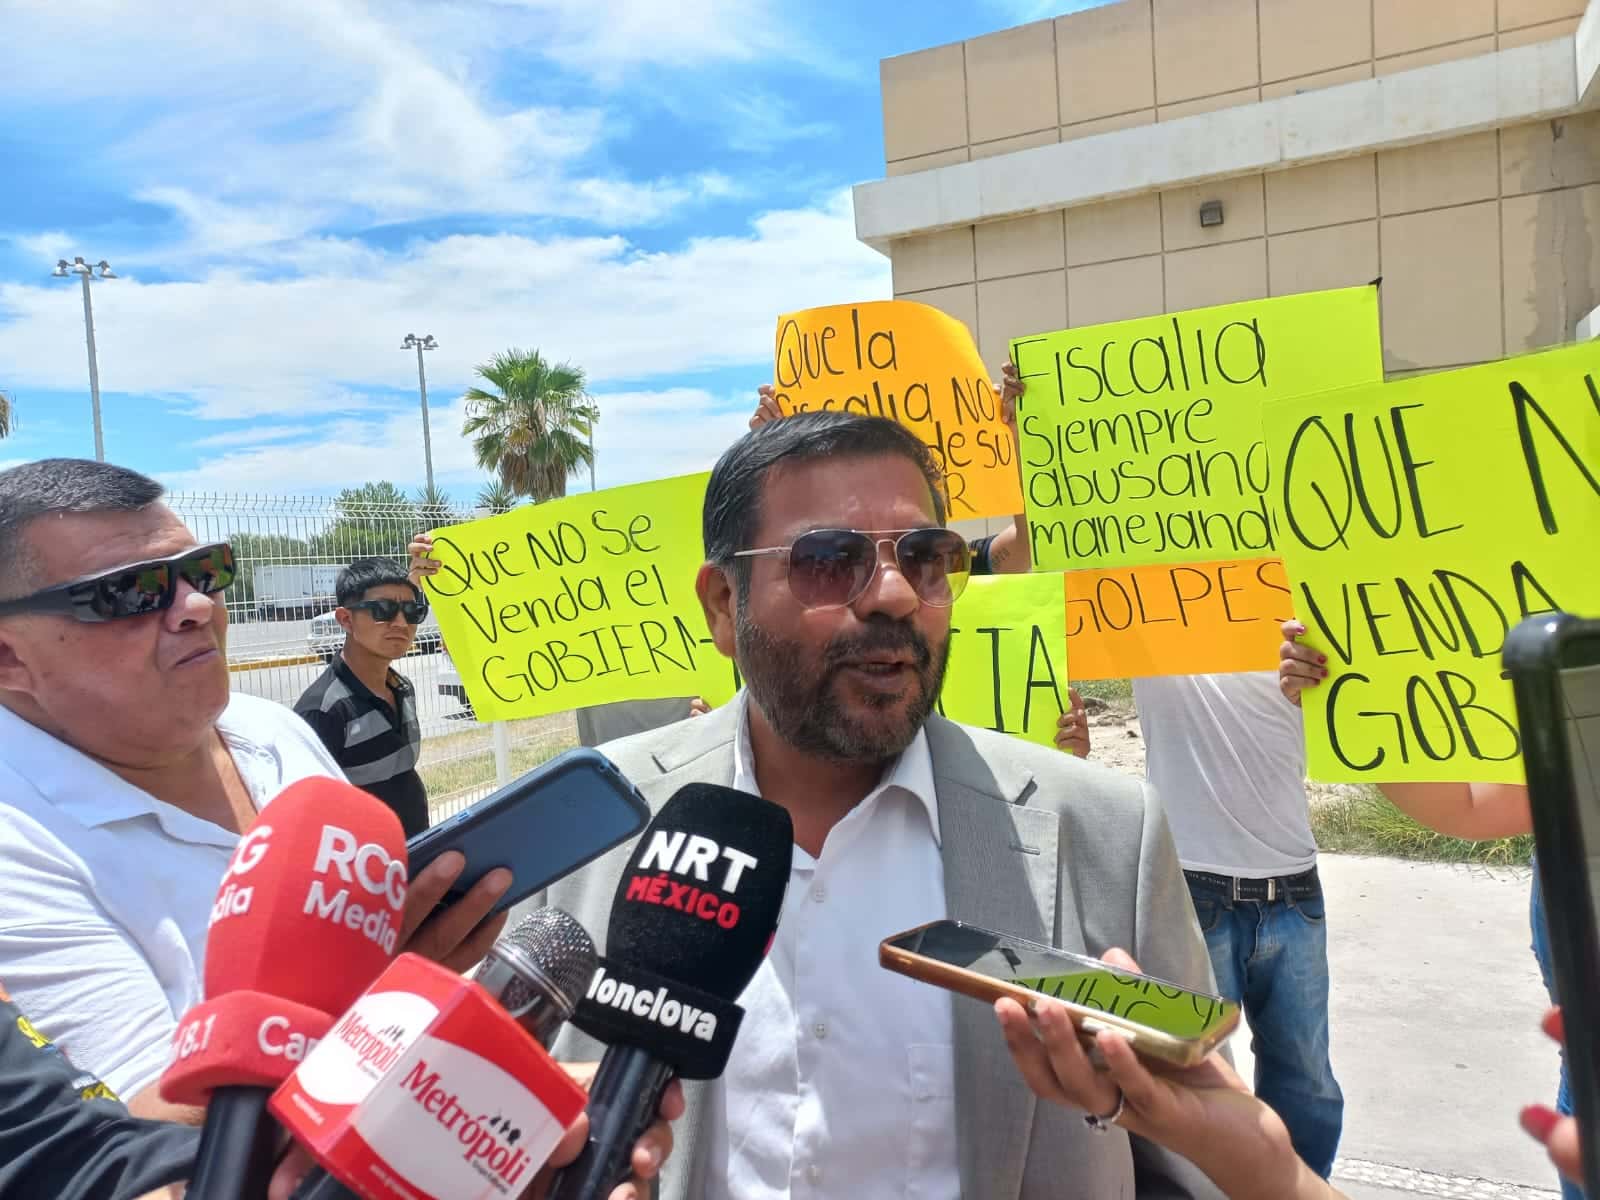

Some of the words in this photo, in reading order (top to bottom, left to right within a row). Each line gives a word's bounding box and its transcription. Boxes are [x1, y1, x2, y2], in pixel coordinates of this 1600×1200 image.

[776, 320, 844, 389] Que
[852, 309, 898, 371] la
[952, 377, 995, 425] NO
[1284, 404, 1464, 552] QUE
[424, 536, 526, 597] Que
[526, 521, 587, 570] NO
[626, 563, 668, 606] el
[1300, 560, 1562, 666] VENDA
[1326, 669, 1522, 771] GOB
[313, 824, 407, 911] RCG
[626, 872, 740, 929] MÉXICO
[638, 830, 758, 894] NRT
[303, 881, 399, 957] Media
[400, 1060, 532, 1187] Metrópoli
